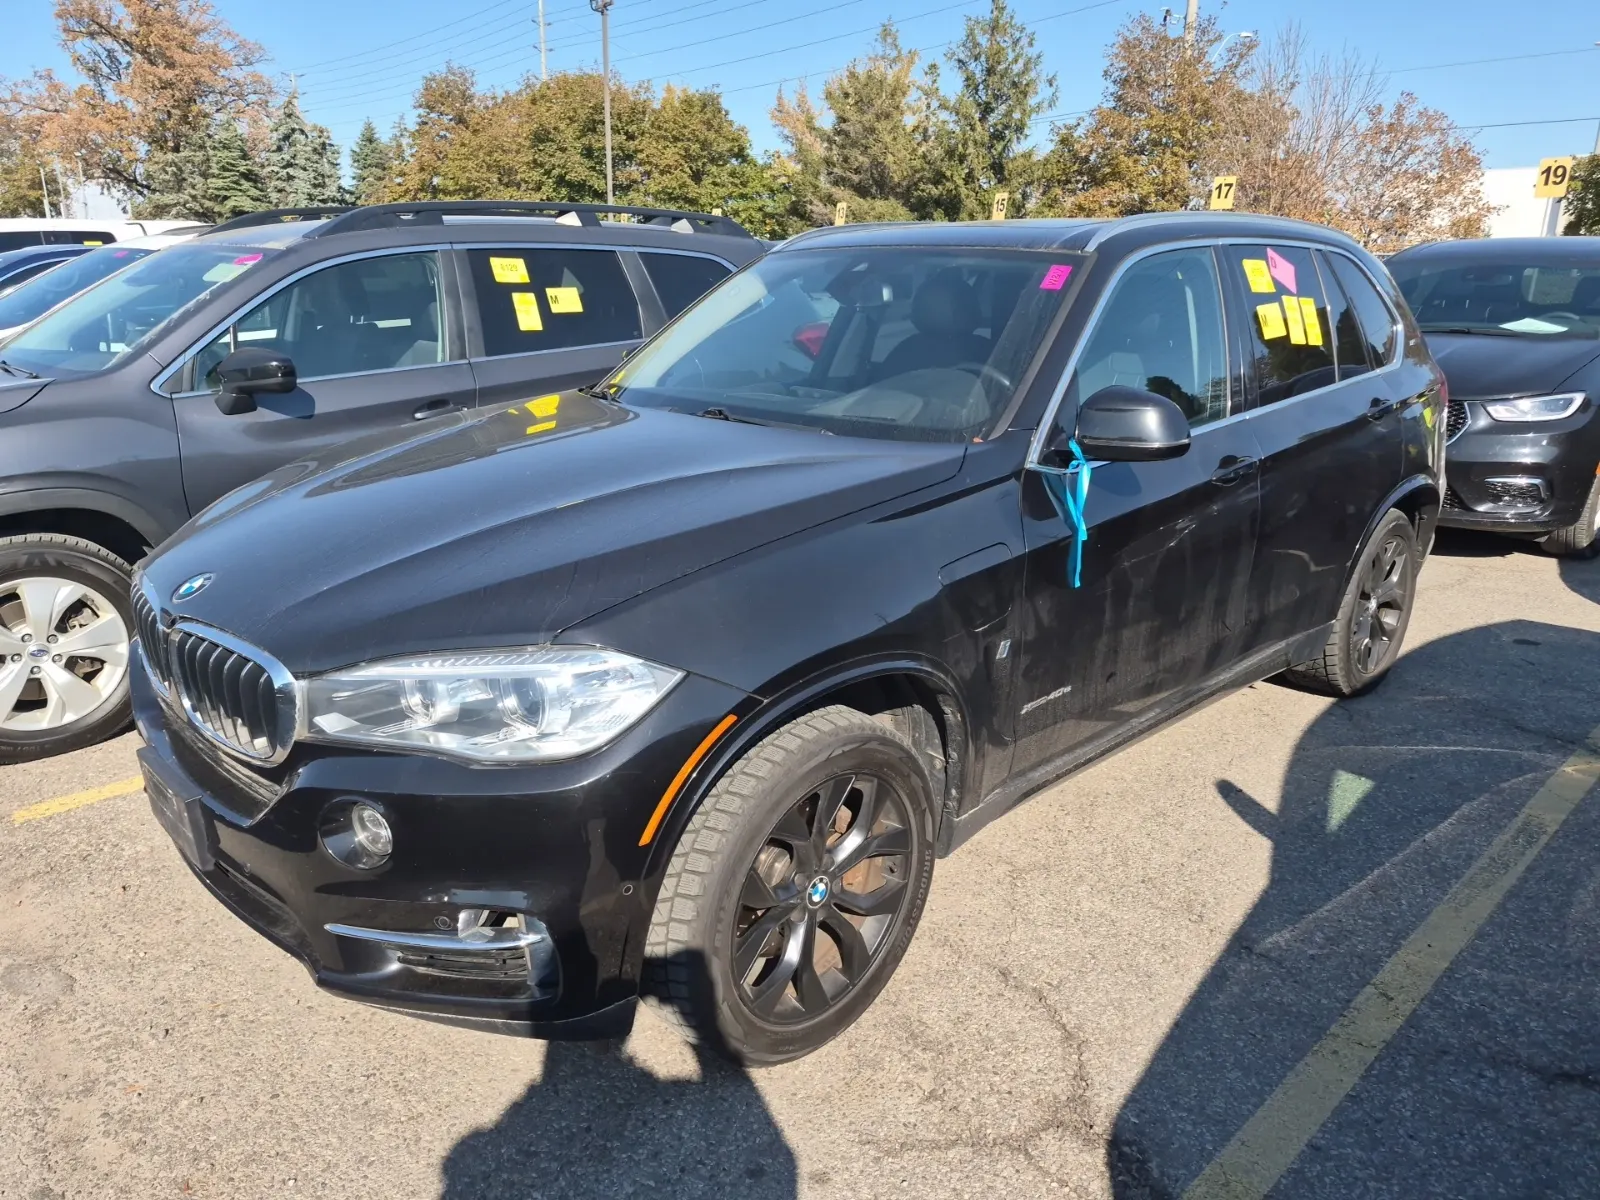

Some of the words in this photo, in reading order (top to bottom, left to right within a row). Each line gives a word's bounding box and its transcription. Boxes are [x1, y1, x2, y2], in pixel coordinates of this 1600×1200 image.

[1540, 164, 1568, 187] 19
[1215, 182, 1234, 199] 17
[995, 198, 1006, 212] 15
[549, 295, 560, 305] M
